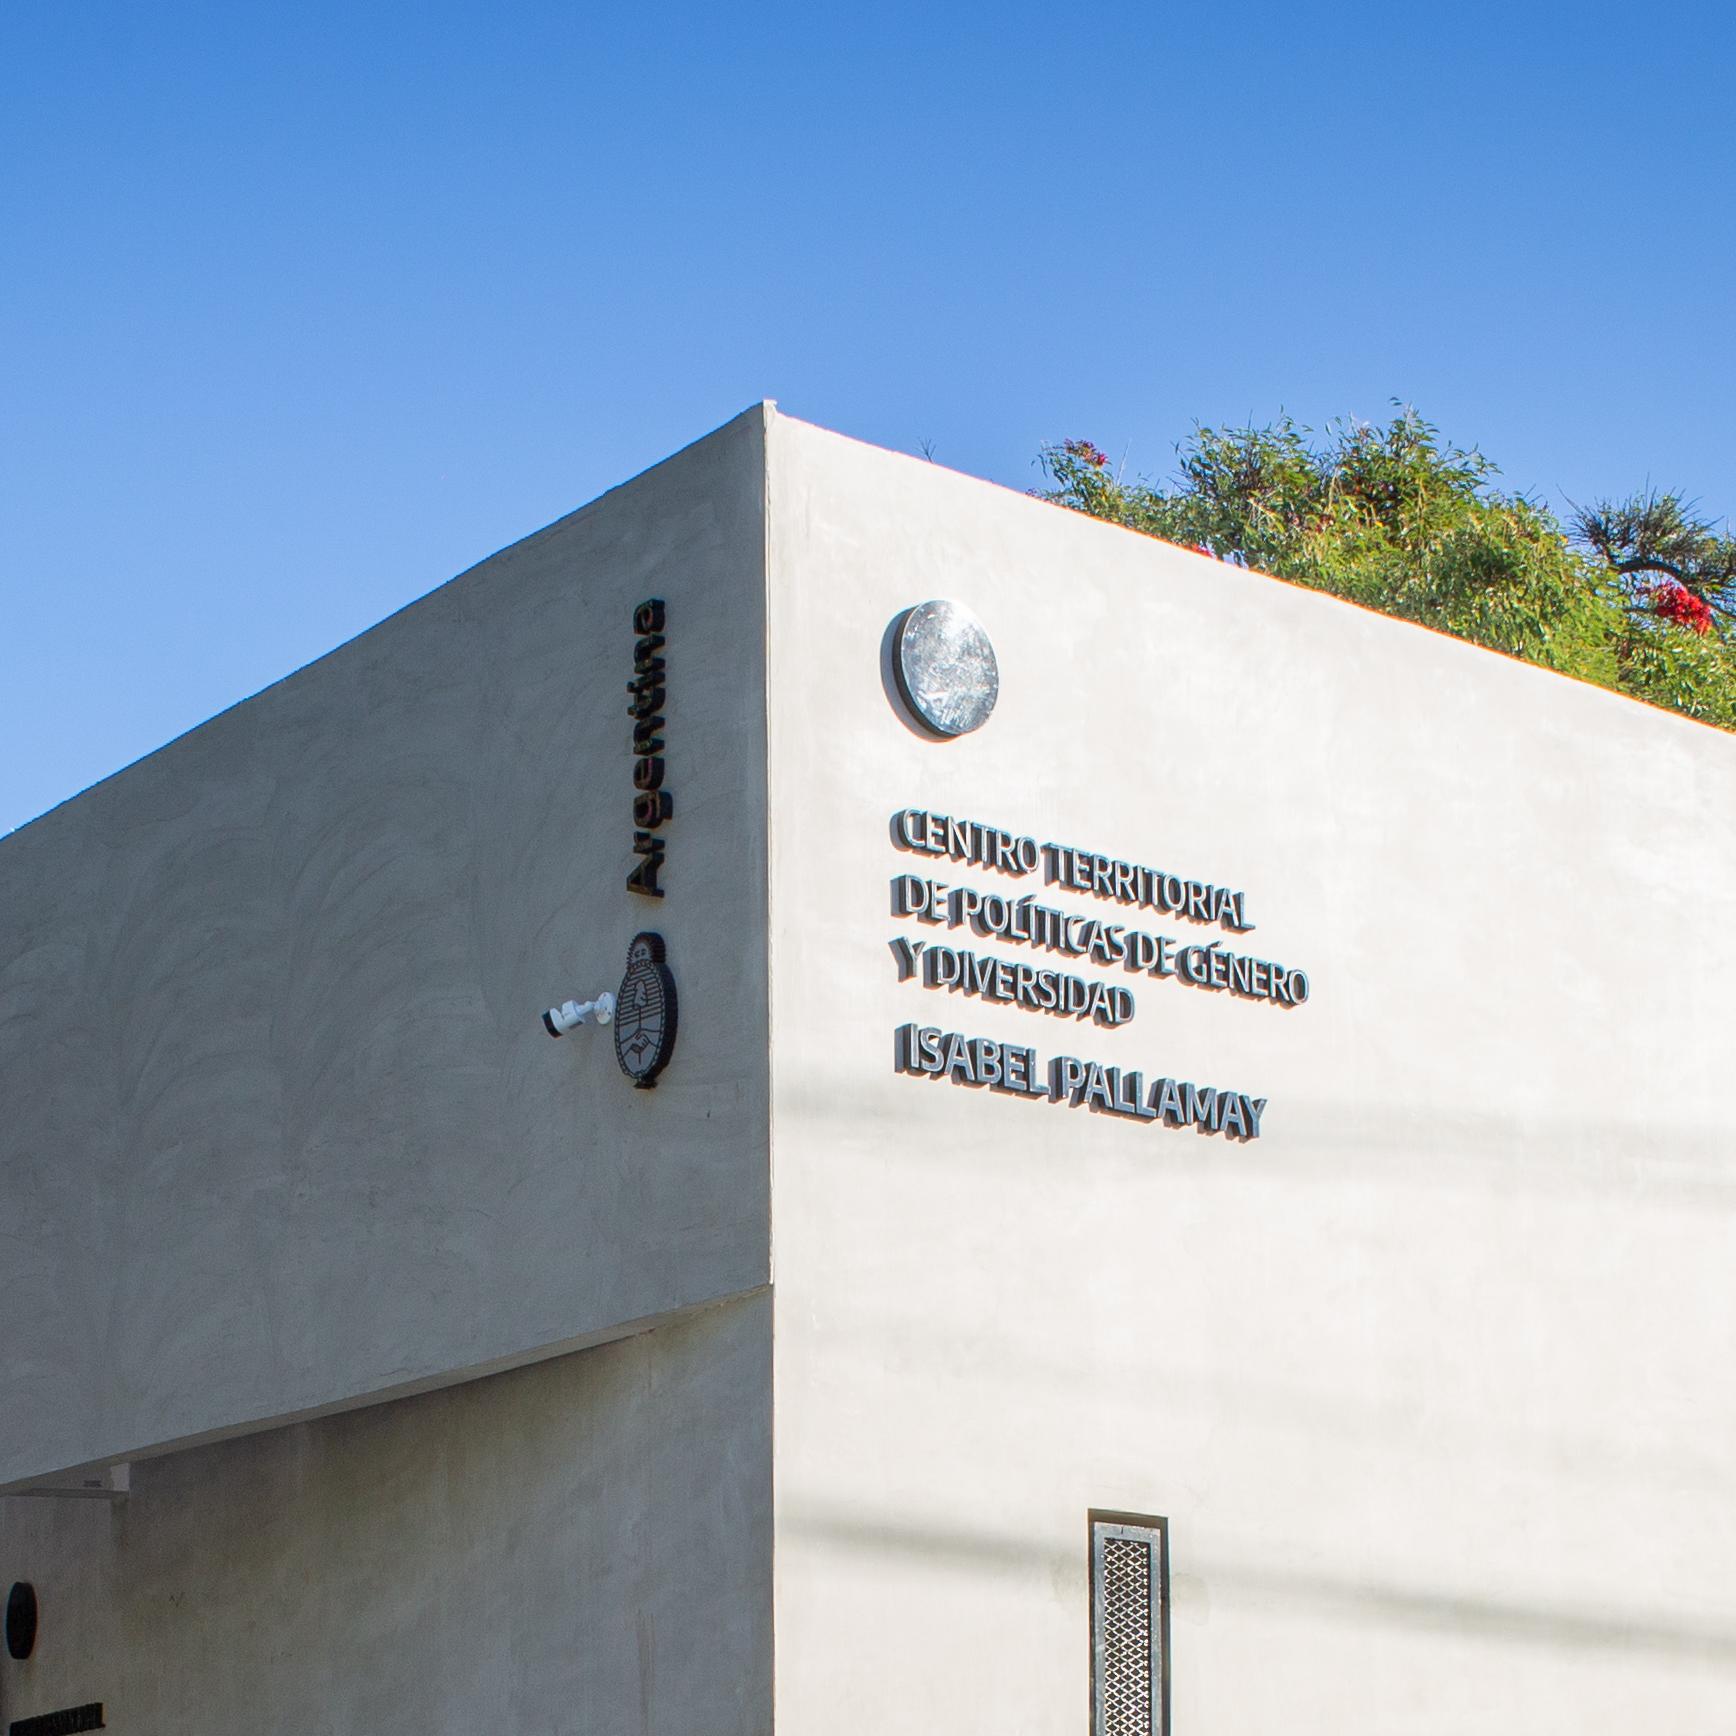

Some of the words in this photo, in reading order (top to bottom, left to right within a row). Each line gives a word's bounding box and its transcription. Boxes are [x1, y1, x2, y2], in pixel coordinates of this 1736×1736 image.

[626, 598, 673, 898] Argentina
[889, 808, 1040, 875] CENTRO
[1041, 842, 1256, 934] TERRITORIAL
[888, 937, 926, 982] Y
[924, 946, 1135, 1030] DIVERSIDAD
[890, 874, 950, 922] DE
[949, 889, 1129, 966] POLÍTICAS
[1124, 931, 1177, 977] DE
[1176, 942, 1310, 1011] GÉNERO
[894, 1022, 1050, 1101] ISABEL
[1048, 1055, 1267, 1143] PALLAMAY
